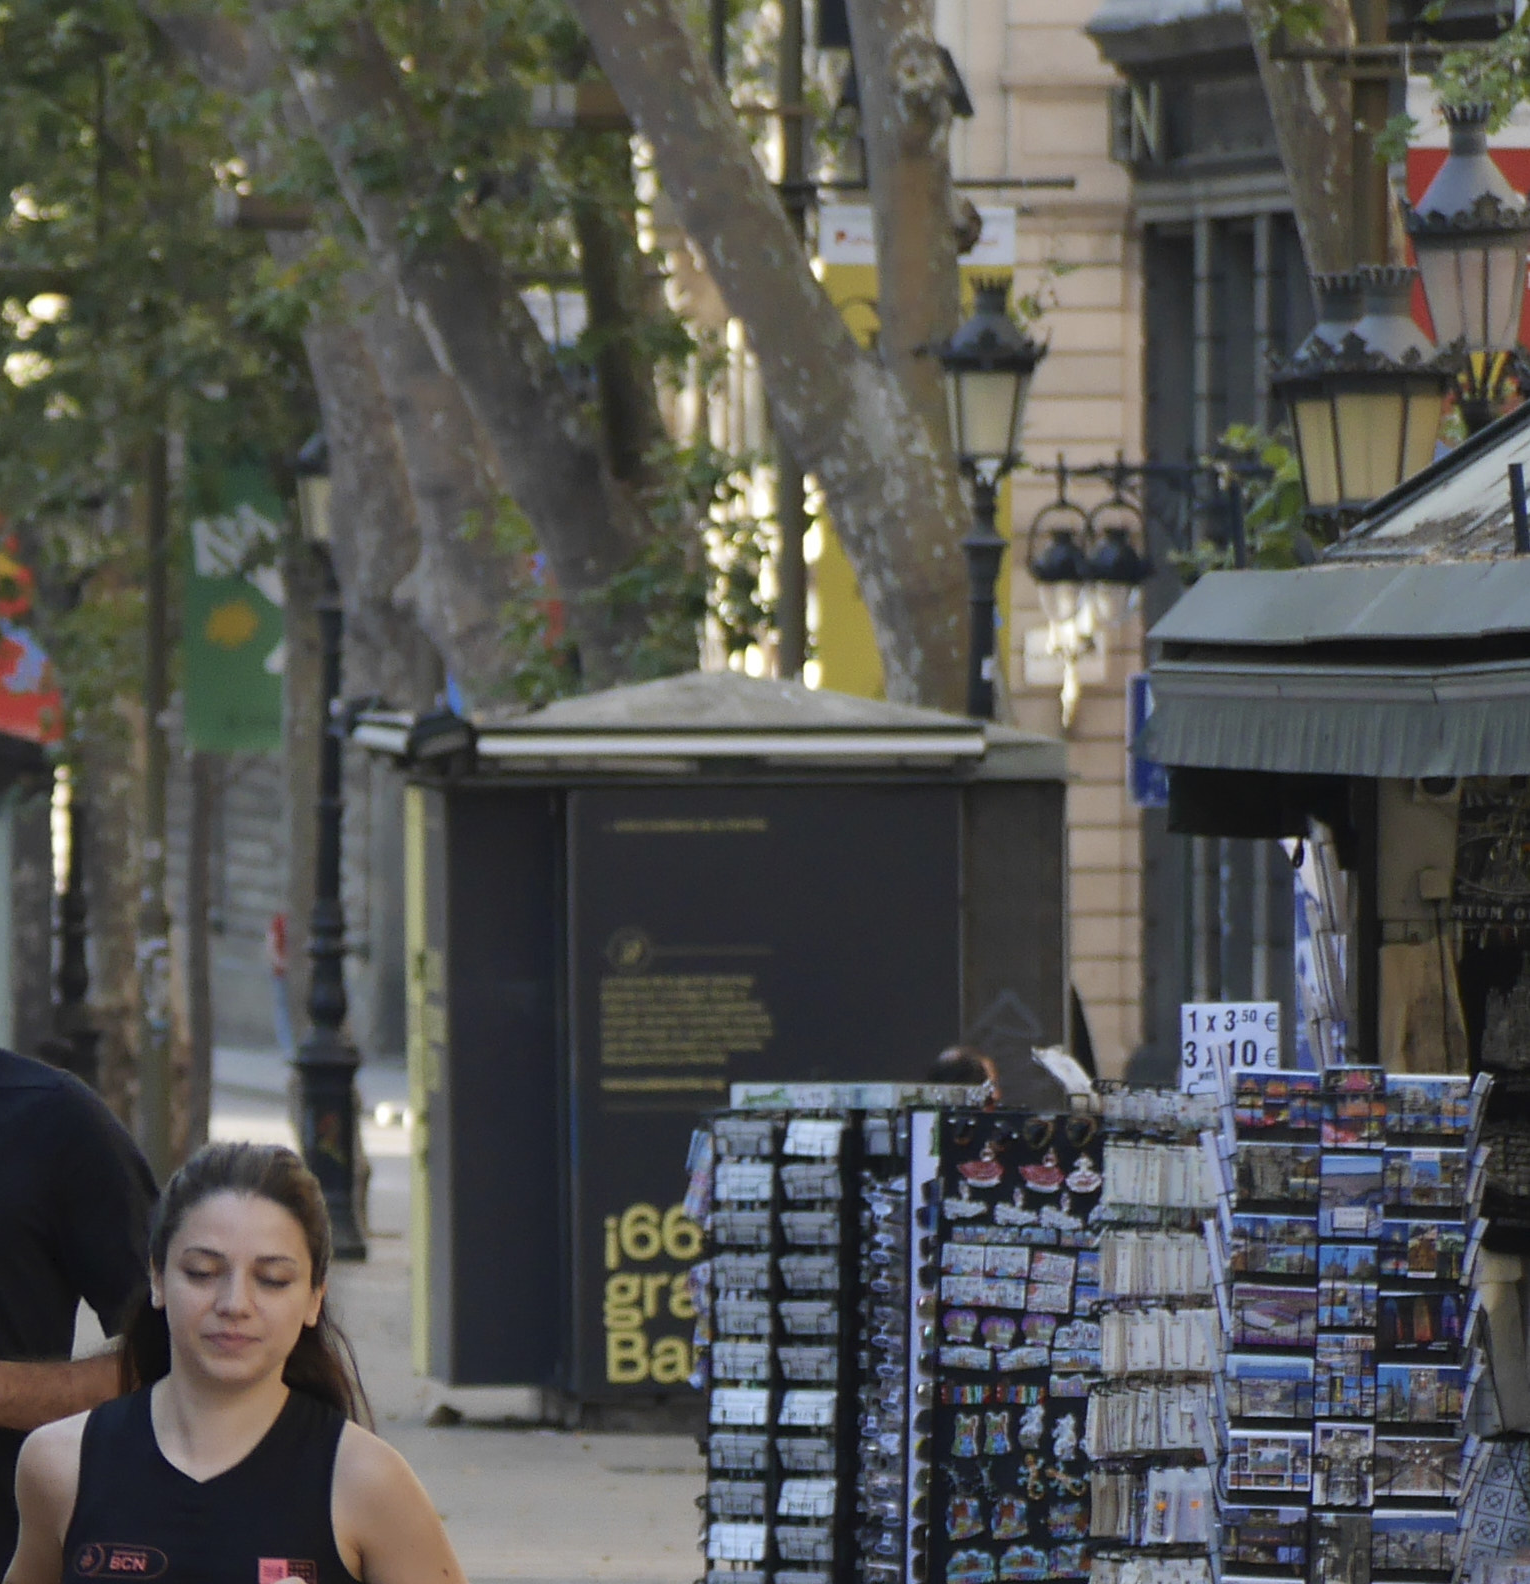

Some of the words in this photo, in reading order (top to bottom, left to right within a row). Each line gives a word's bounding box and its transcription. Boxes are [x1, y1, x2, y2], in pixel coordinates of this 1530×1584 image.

[1188, 1010, 1197, 1032] 1
[1206, 1015, 1216, 1032] x
[1224, 1009, 1257, 1032] 3.50
[1264, 1011, 1279, 1032] €
[1184, 1040, 1197, 1068] 3
[1227, 1039, 1257, 1067] 10
[1264, 1047, 1279, 1067] €
[109, 1556, 147, 1572] BCN
